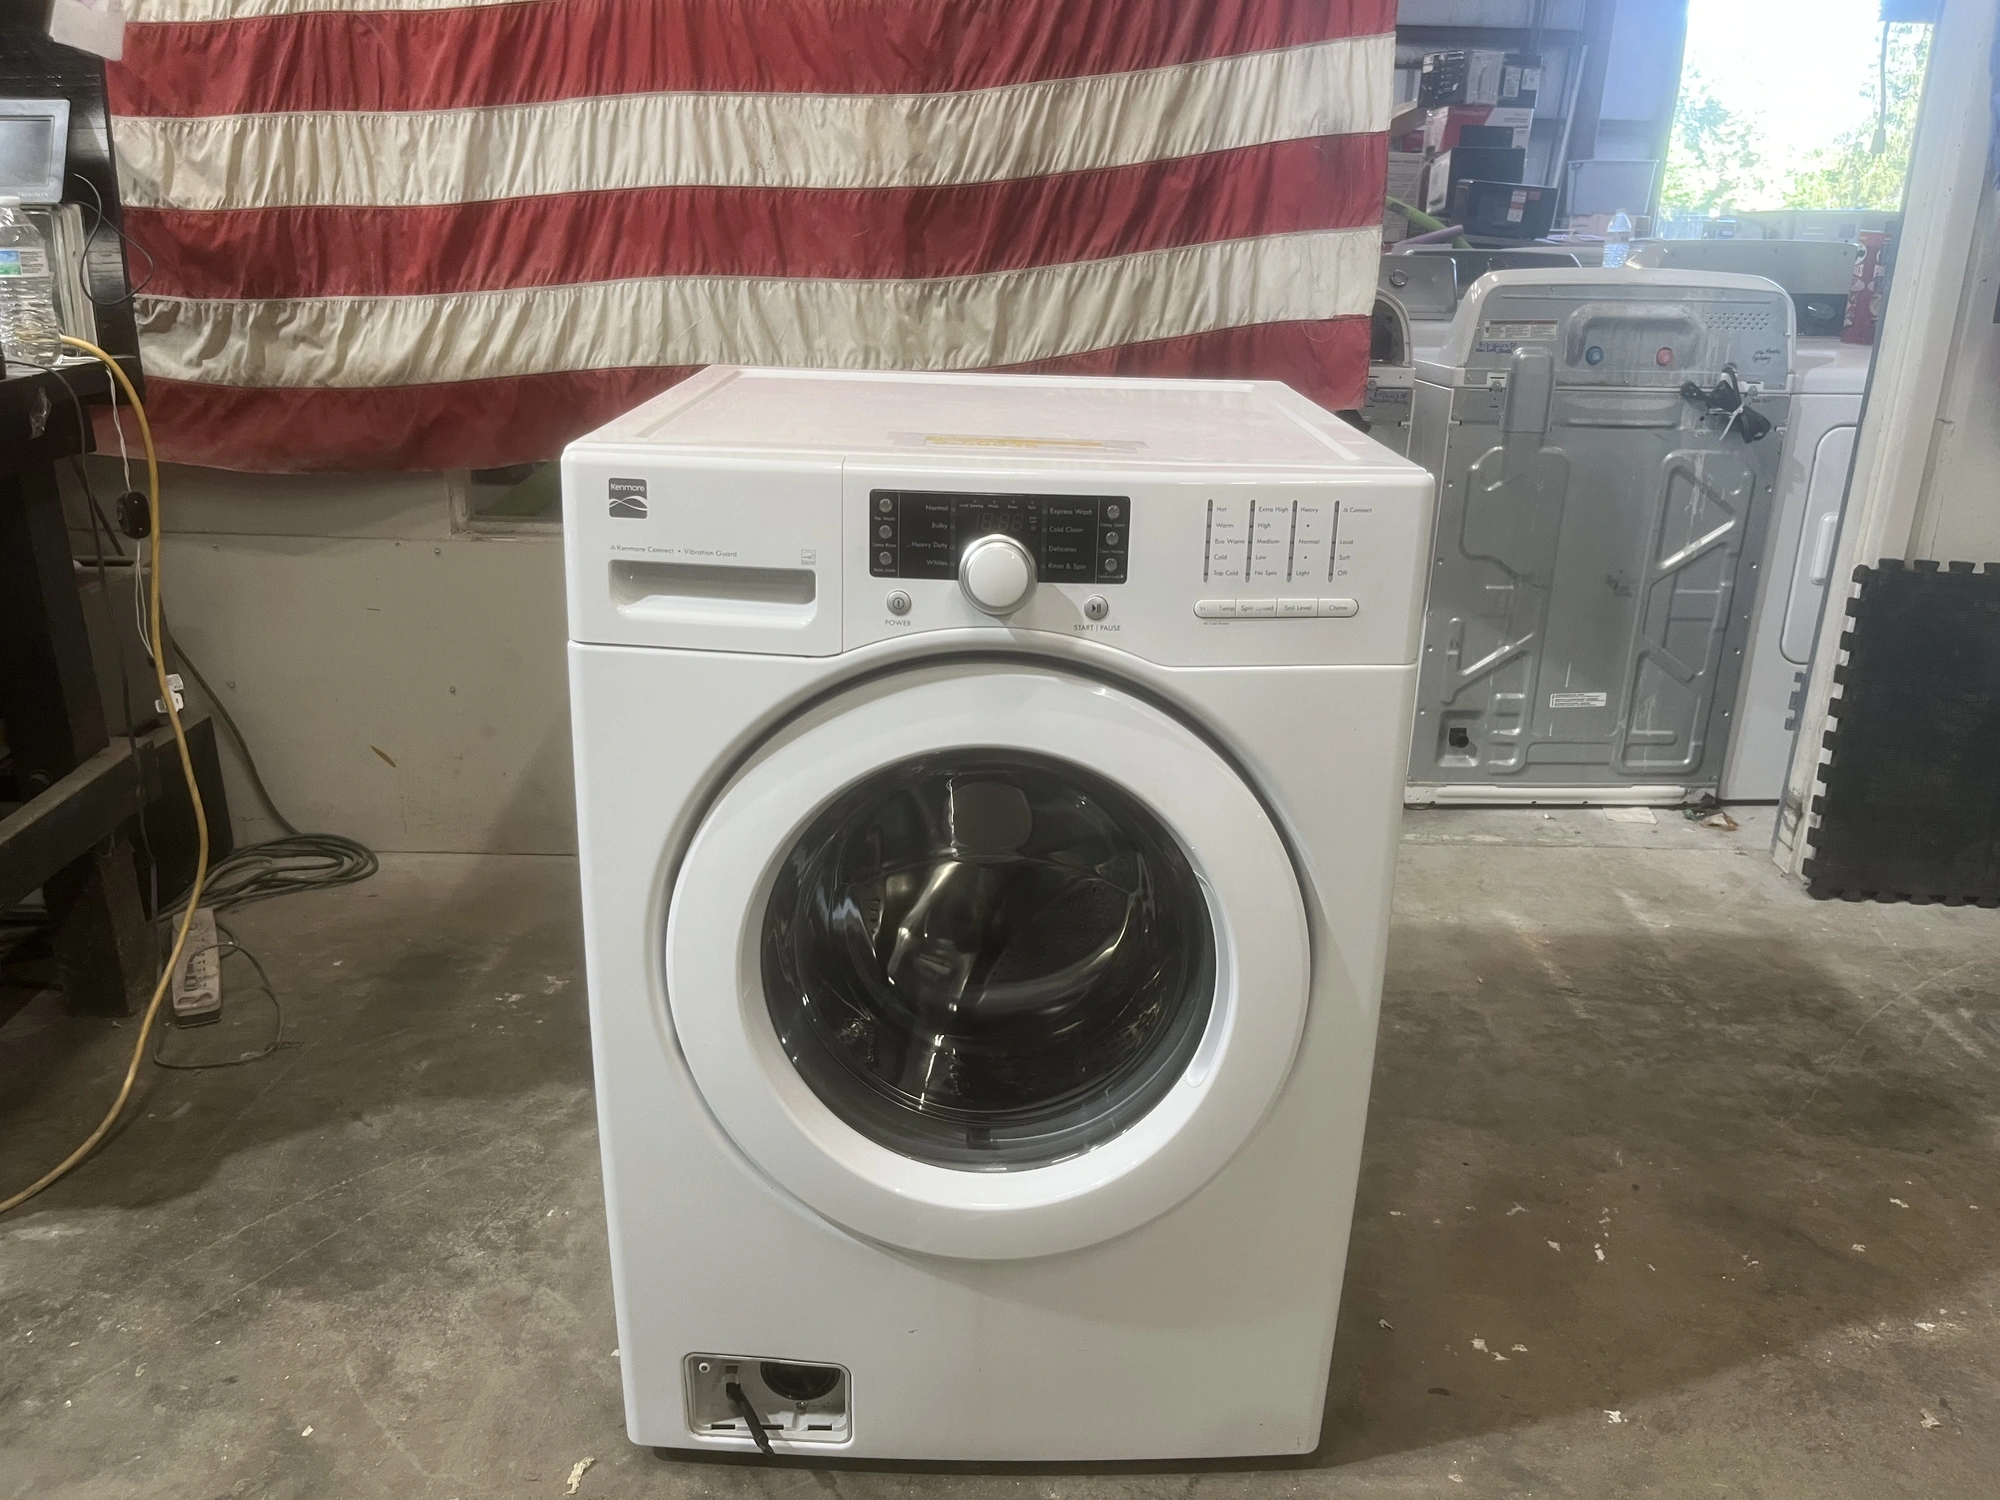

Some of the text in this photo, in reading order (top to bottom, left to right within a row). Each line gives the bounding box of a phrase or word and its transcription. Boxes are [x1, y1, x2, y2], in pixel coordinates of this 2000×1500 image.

[610, 483, 645, 492] Kenmore
[1050, 507, 1073, 516] Express
[1274, 506, 1289, 514] High
[1300, 506, 1319, 514] Heavy
[932, 522, 948, 530] Bulky
[911, 541, 948, 549] Heavy Duty
[1048, 545, 1077, 553] Delicates
[616, 544, 737, 558] Kenmore Connect Vibration Guard
[925, 558, 948, 566] Whites
[1264, 570, 1277, 578] Spin
[1296, 569, 1310, 577] Light
[1240, 605, 1254, 613] Spin
[885, 619, 912, 627] POWER
[1074, 624, 1121, 632] START PAUSE
